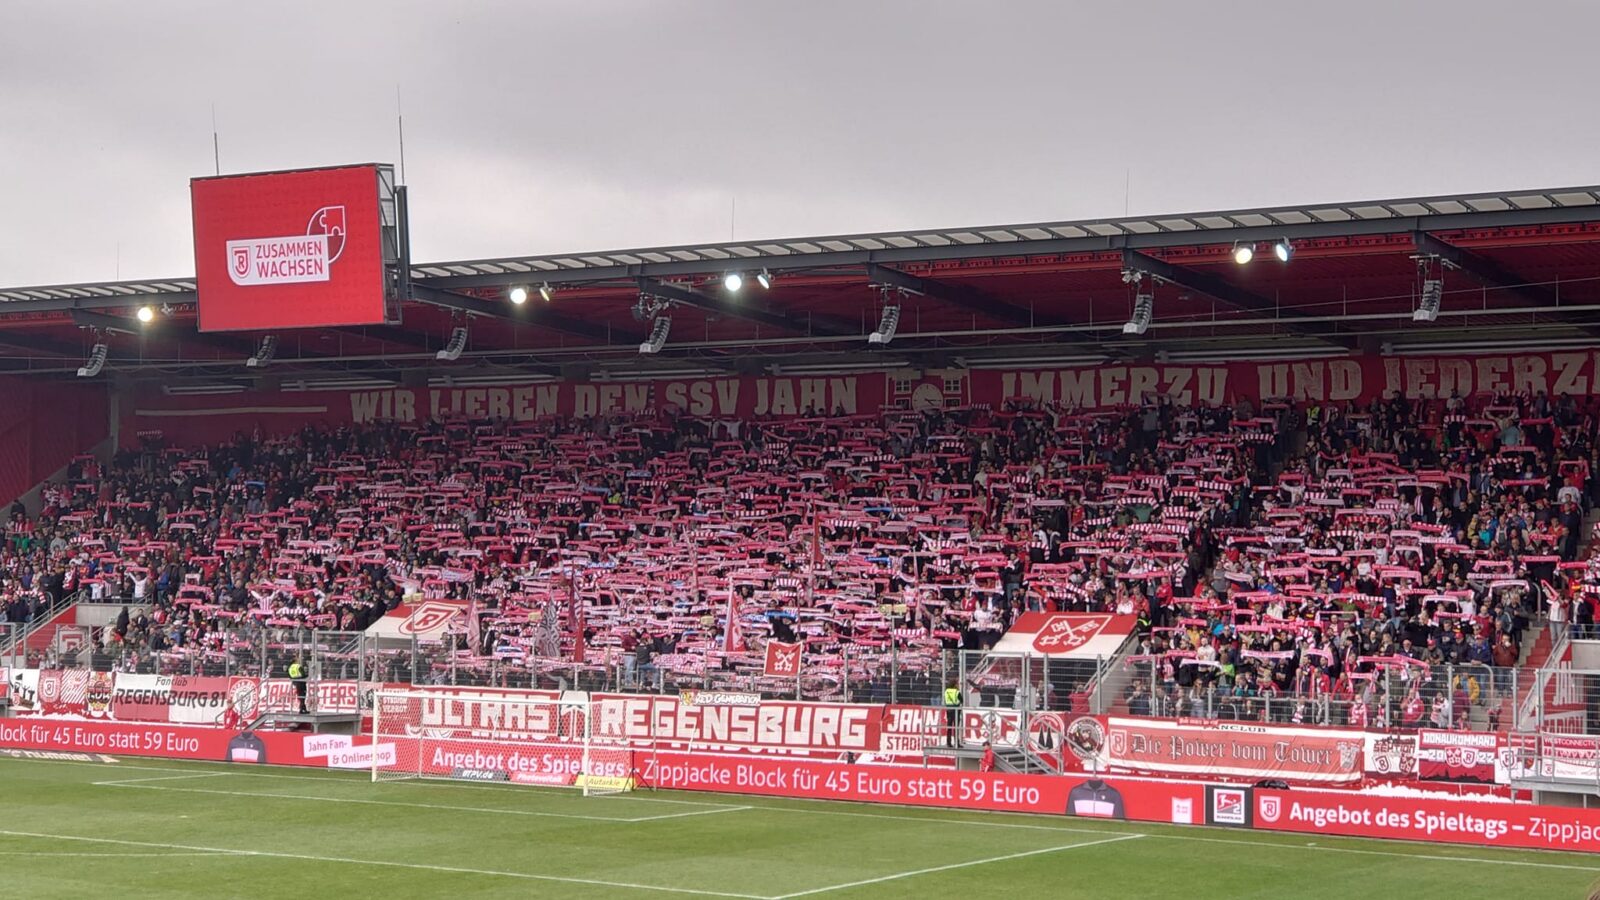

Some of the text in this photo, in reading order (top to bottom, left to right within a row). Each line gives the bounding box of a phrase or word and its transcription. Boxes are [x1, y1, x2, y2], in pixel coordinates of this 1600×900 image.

[256, 241, 322, 259] ZUSAMMEN
[256, 259, 323, 278] WACHSEN
[1001, 352, 1600, 410] IMMERZU UND JEDERZ
[350, 377, 857, 424] WIR LIEBEN DEN SSV JAHN
[155, 676, 188, 687] Fanclub
[115, 688, 208, 709] REGENSBURG
[210, 690, 226, 708] 81
[422, 690, 869, 747] ULTRAS REGENSBURG
[887, 708, 940, 734] JAHN
[31, 725, 50, 743] für
[53, 727, 70, 745] 45
[75, 728, 105, 747] Euro
[109, 731, 140, 749] statt
[144, 732, 163, 751] 59
[167, 734, 199, 752] Euro
[308, 740, 347, 752] Jahn Fan-
[1131, 733, 1161, 755] Die
[1169, 735, 1226, 760] Power
[1232, 741, 1266, 761] vom
[1273, 741, 1333, 765] Tower
[432, 747, 503, 770] Angebot
[508, 752, 537, 771] des
[643, 759, 731, 787] Zippjacke
[737, 763, 786, 788] Block
[793, 764, 820, 790] für
[825, 770, 850, 793] 45
[857, 773, 901, 796] Euro
[908, 777, 952, 799] statt
[960, 778, 985, 801] 59
[993, 782, 1039, 804] Euro
[1290, 803, 1371, 828] Angebot
[1375, 807, 1410, 826] des
[1414, 810, 1508, 839] Spieltags
